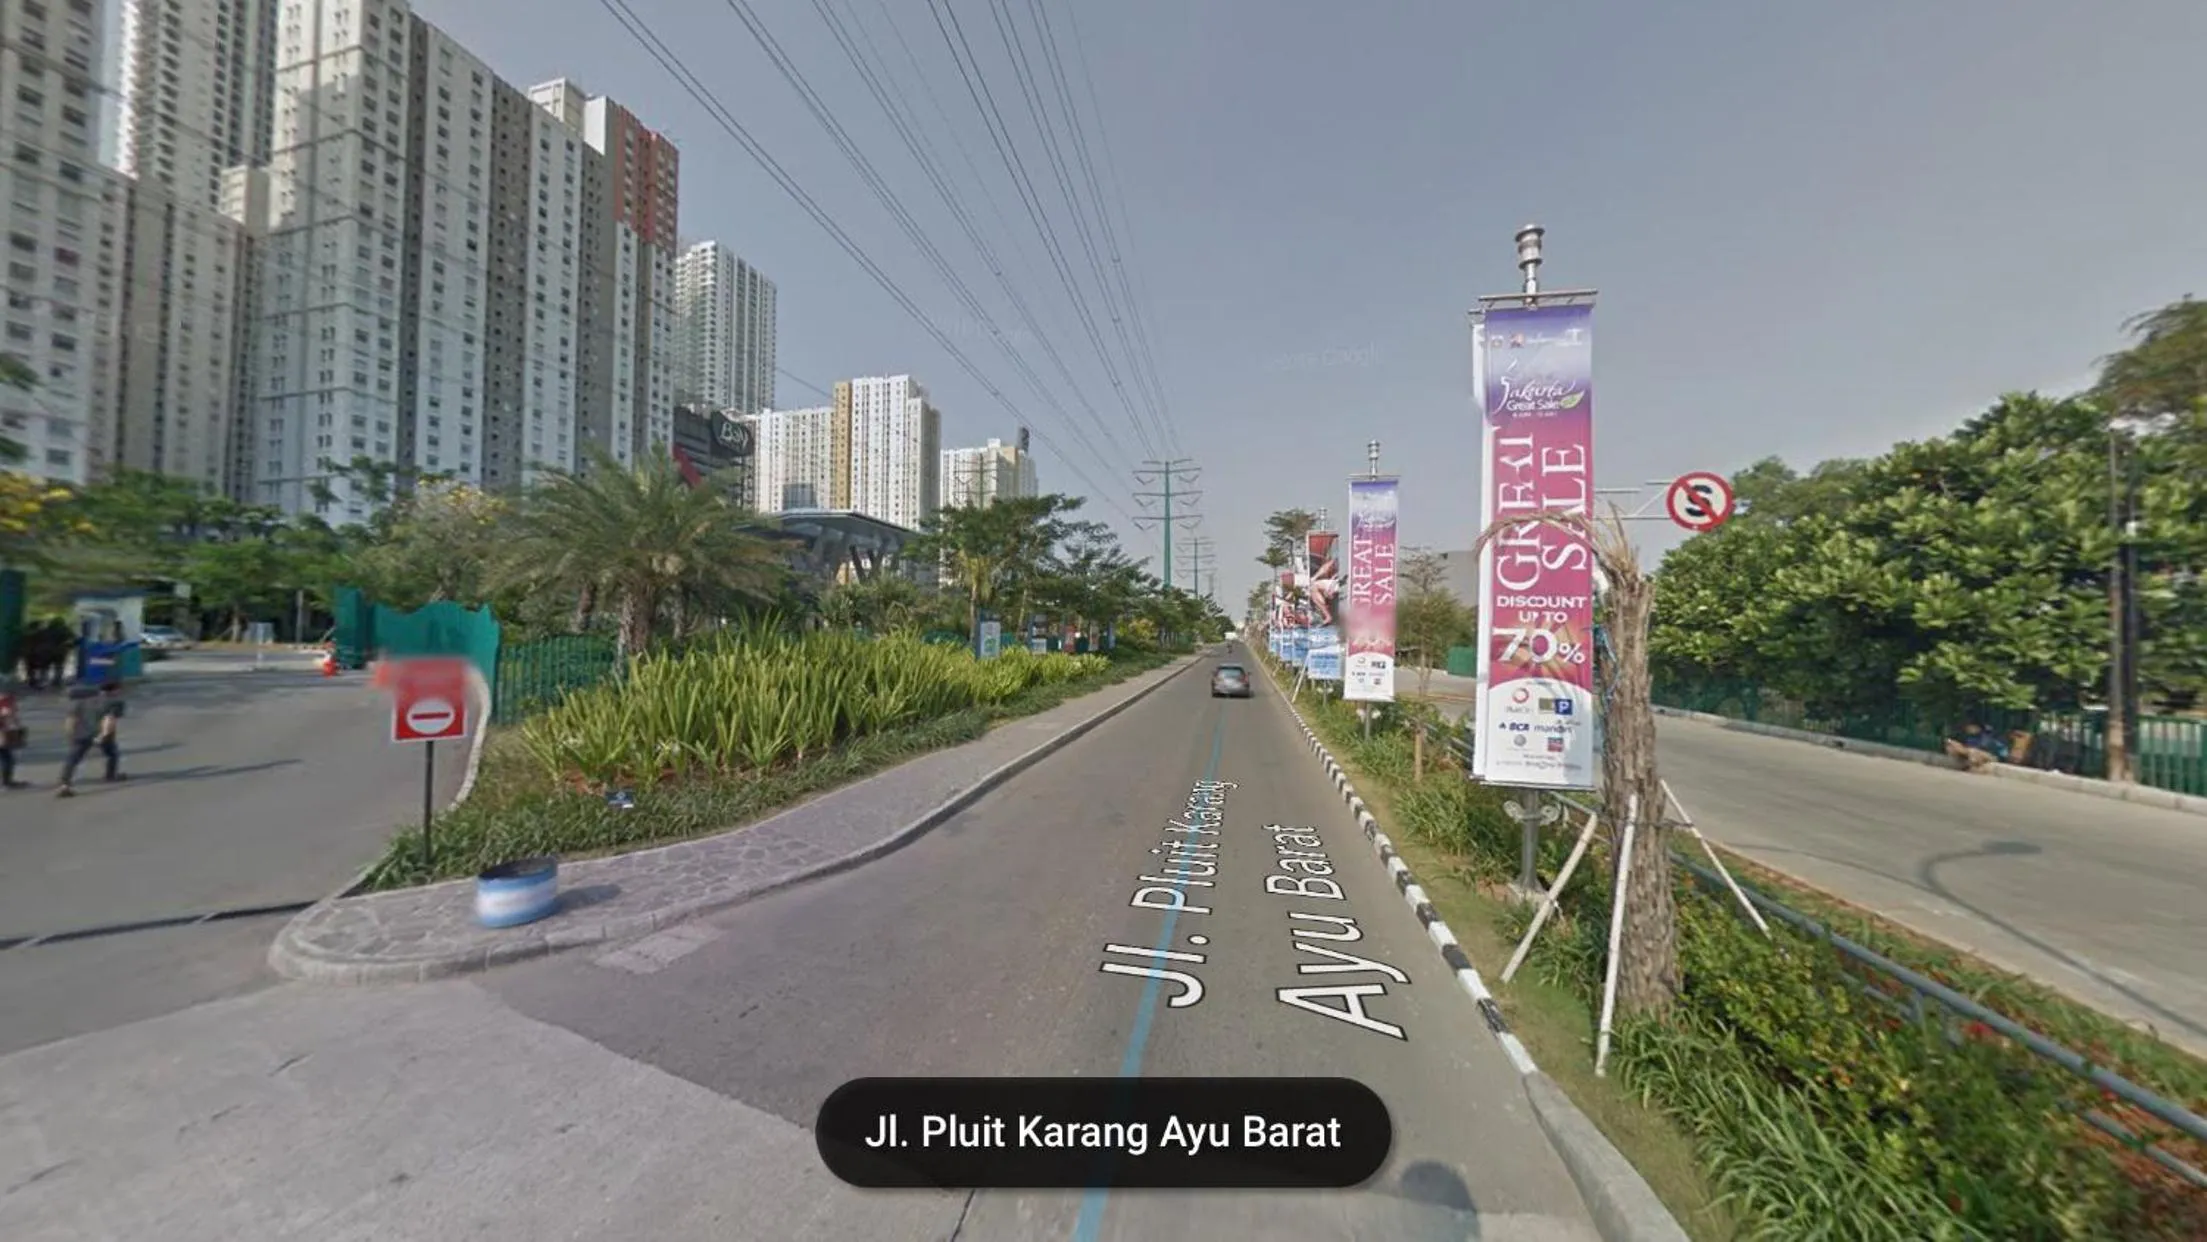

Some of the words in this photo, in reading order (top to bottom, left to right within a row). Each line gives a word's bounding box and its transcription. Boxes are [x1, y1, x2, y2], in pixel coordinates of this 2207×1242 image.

[1506, 400, 1535, 411] Great
[1542, 444, 1587, 570] SALE
[1373, 543, 1394, 605] SALE
[1496, 595, 1587, 609] DISCOUNT
[1519, 611, 1539, 623] UP
[1542, 611, 1568, 623] TO
[1492, 627, 1585, 664] 70%
